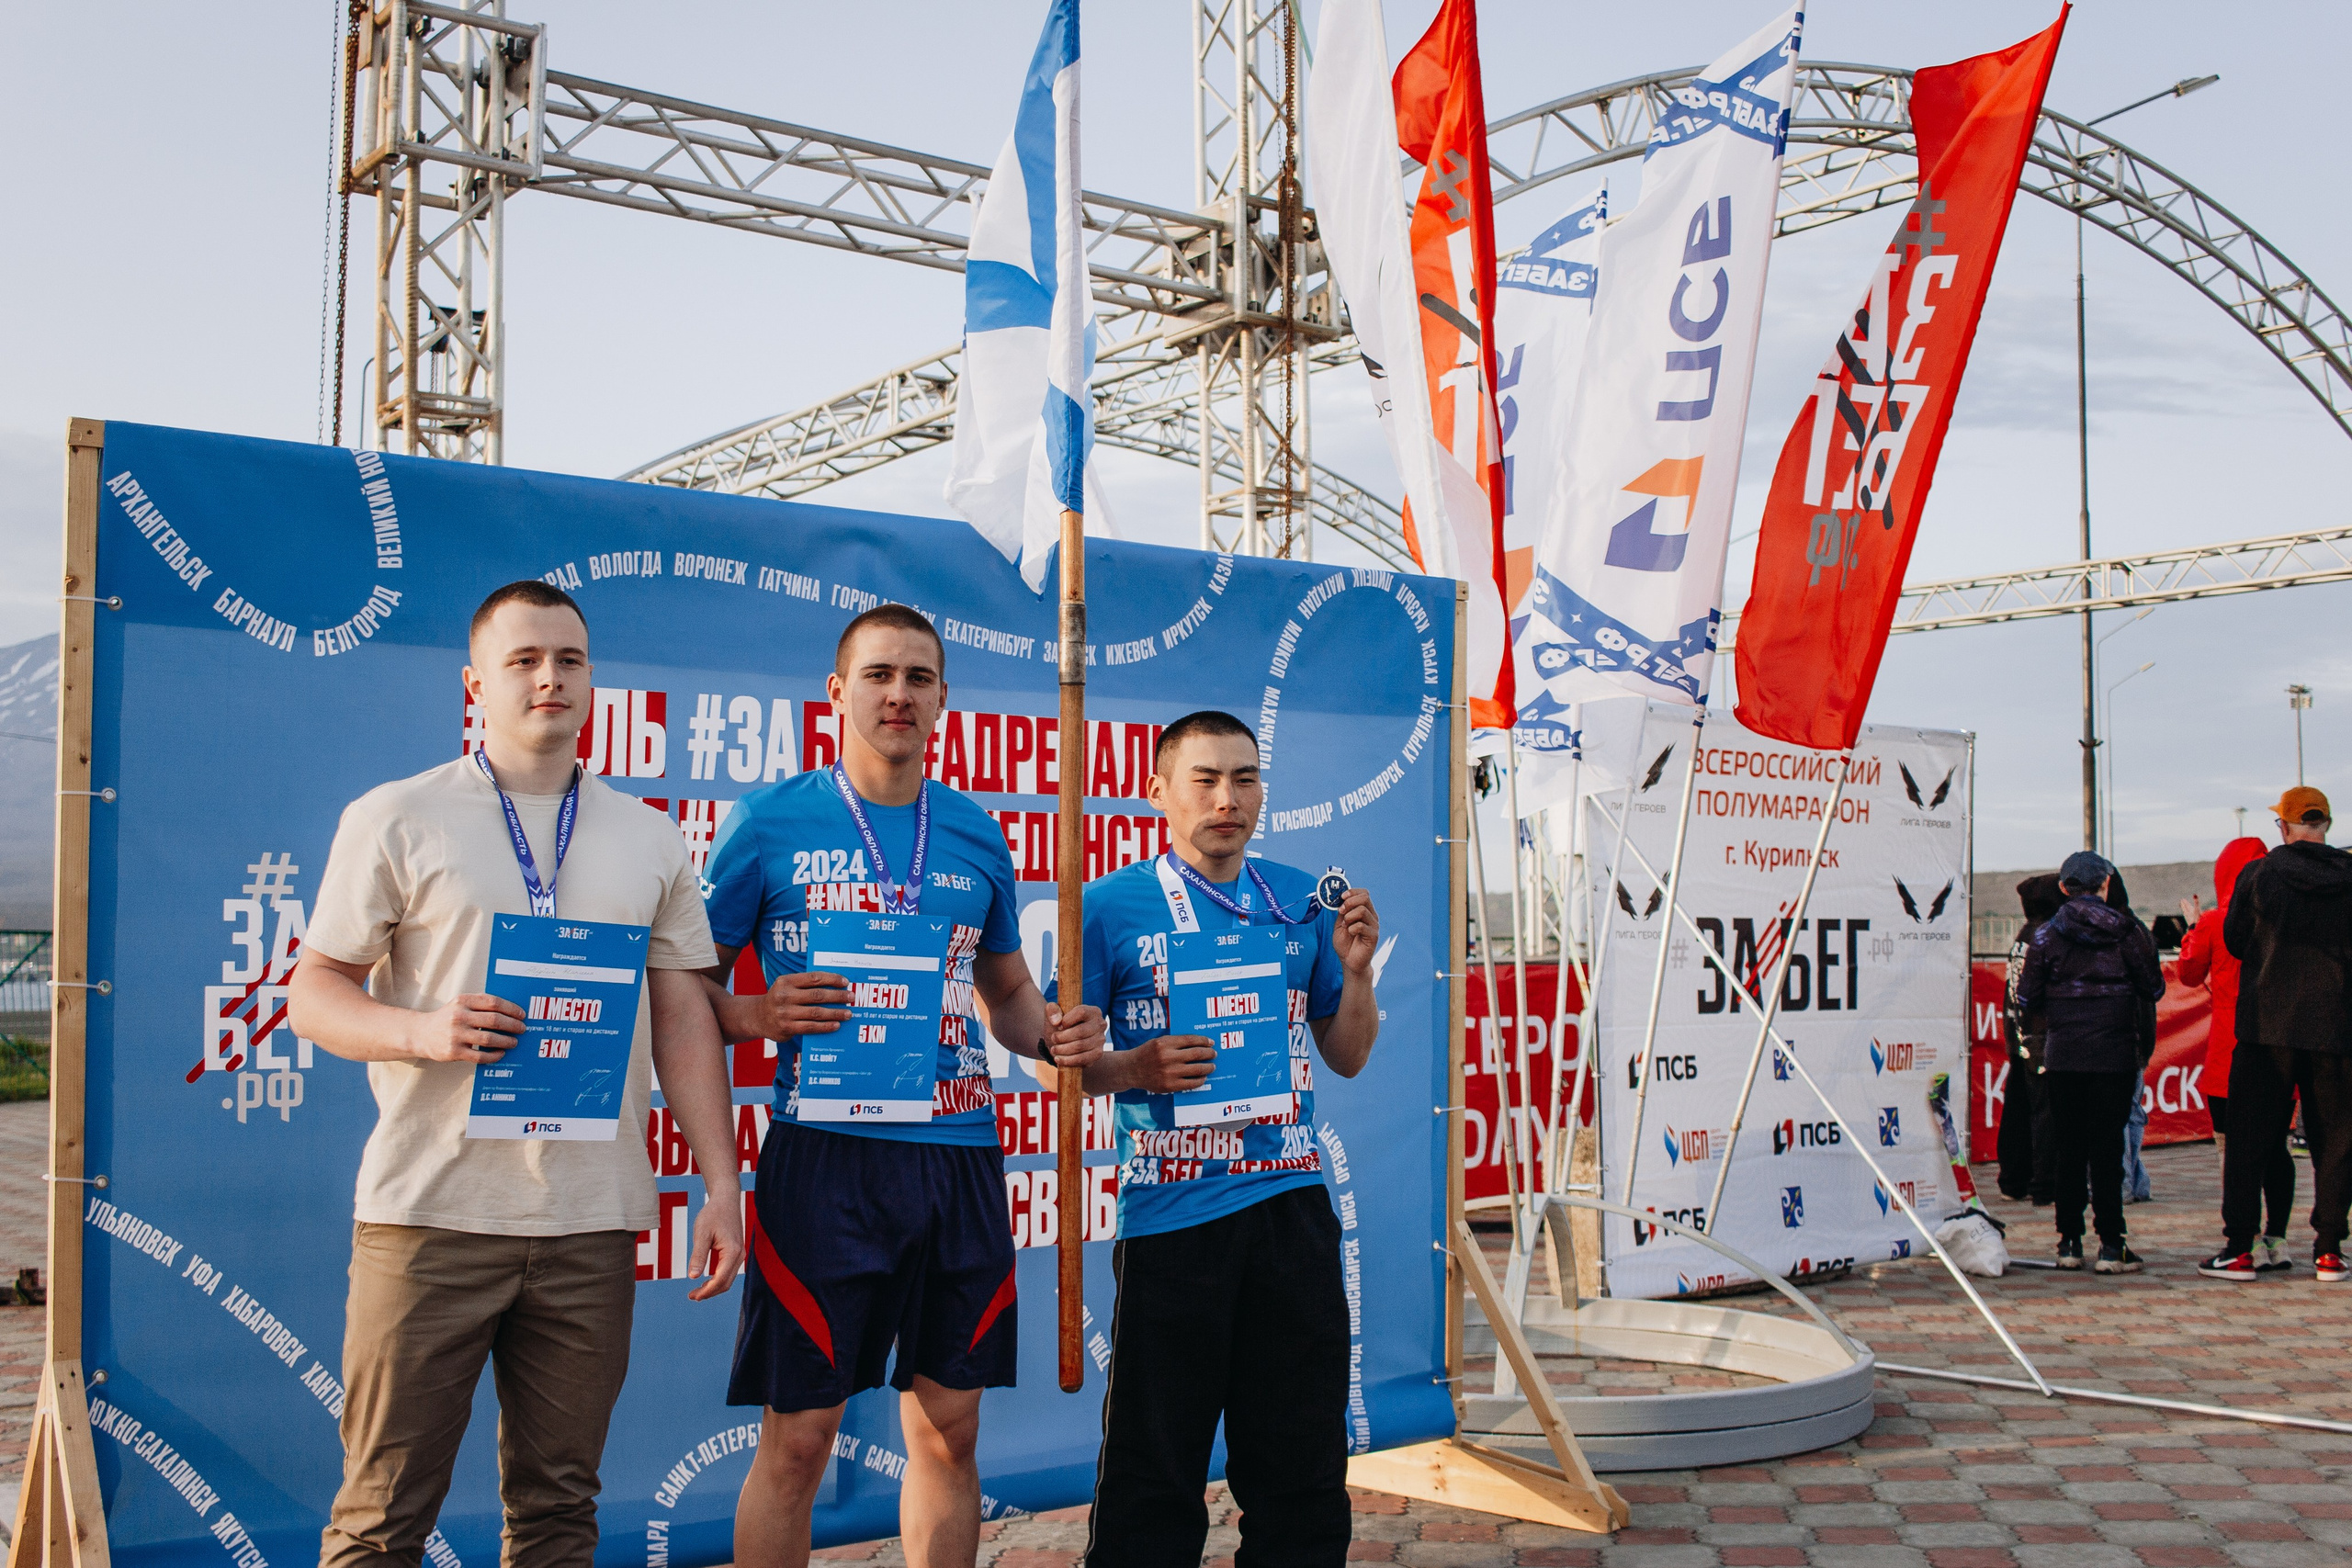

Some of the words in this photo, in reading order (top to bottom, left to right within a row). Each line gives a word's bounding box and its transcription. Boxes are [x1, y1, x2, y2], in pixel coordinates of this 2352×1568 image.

[106, 470, 213, 592] АРХАНГЕЛЬСК
[213, 587, 298, 652] БАРНАУЛ
[313, 584, 402, 657] БЕЛГОРОД
[359, 477, 403, 569] ВЕЛИКИЙ
[1351, 568, 1394, 592] ЛИПЕЦК
[589, 551, 662, 581] ВОЛОГДА
[674, 552, 749, 586] ВОРОНЕЖ
[758, 566, 820, 603] ГАТЧИНА
[944, 618, 1035, 660] ЕКАТЕРИНБУРГ
[1106, 636, 1158, 666] ИЖЕВСК
[1162, 596, 1214, 650] ИРКУТСК
[1297, 571, 1346, 620] МАГАДАН
[1396, 583, 1430, 634] КЫЗЫЛ
[1270, 619, 1303, 679] МАЙКОП
[1421, 637, 1439, 684] КУРСК
[1258, 685, 1281, 770] МАХАЧКАЛА
[1402, 694, 1438, 764] КУРИЛЬСК
[1340, 760, 1405, 817] КРАСНОЯРСК
[508, 810, 527, 856] ОБЛАСТЬ
[835, 770, 867, 829] САХАЛИНСКАЯ
[863, 829, 885, 872] ОБЛАСТЬ
[1272, 802, 1333, 833] КРАСНОДАР
[913, 815, 928, 876] САХАЛИНСКАЯ
[1725, 846, 1736, 864] г.
[793, 849, 868, 886] 2024
[1180, 866, 1235, 908] САХАЛИНСКАЯ
[1175, 902, 1190, 923] ПСБ
[528, 996, 547, 1020] III
[547, 997, 603, 1022] МЕСТО
[854, 983, 909, 1009] МЕСТО
[1216, 992, 1260, 1017] МЕСТО
[538, 1039, 548, 1058] 5
[549, 1039, 571, 1058] КМ
[858, 1025, 866, 1043] 5
[867, 1025, 887, 1043] КМ
[1220, 1032, 1227, 1049] 5
[1228, 1031, 1244, 1048] КМ
[1656, 1055, 1698, 1081] ПСБ
[1887, 1043, 1913, 1074] ЦСП
[539, 1123, 561, 1132] ПСБ
[864, 1106, 883, 1114] ПСБ
[1234, 1104, 1251, 1113] ПСБ
[1317, 1122, 1351, 1185] ОРЕНБУРГ
[1682, 1129, 1709, 1164] ЦСП
[1800, 1121, 1841, 1147] ПСБ
[1339, 1190, 1358, 1231] ОМСК
[85, 1197, 184, 1268] УЛЬЯНОВСК
[183, 1254, 223, 1296] УФА
[220, 1284, 309, 1369] ХАБАРОВСК
[1344, 1237, 1362, 1336] НОВОСИБИРСК
[89, 1396, 220, 1517] ЮЖНО-САХАЛИНСК
